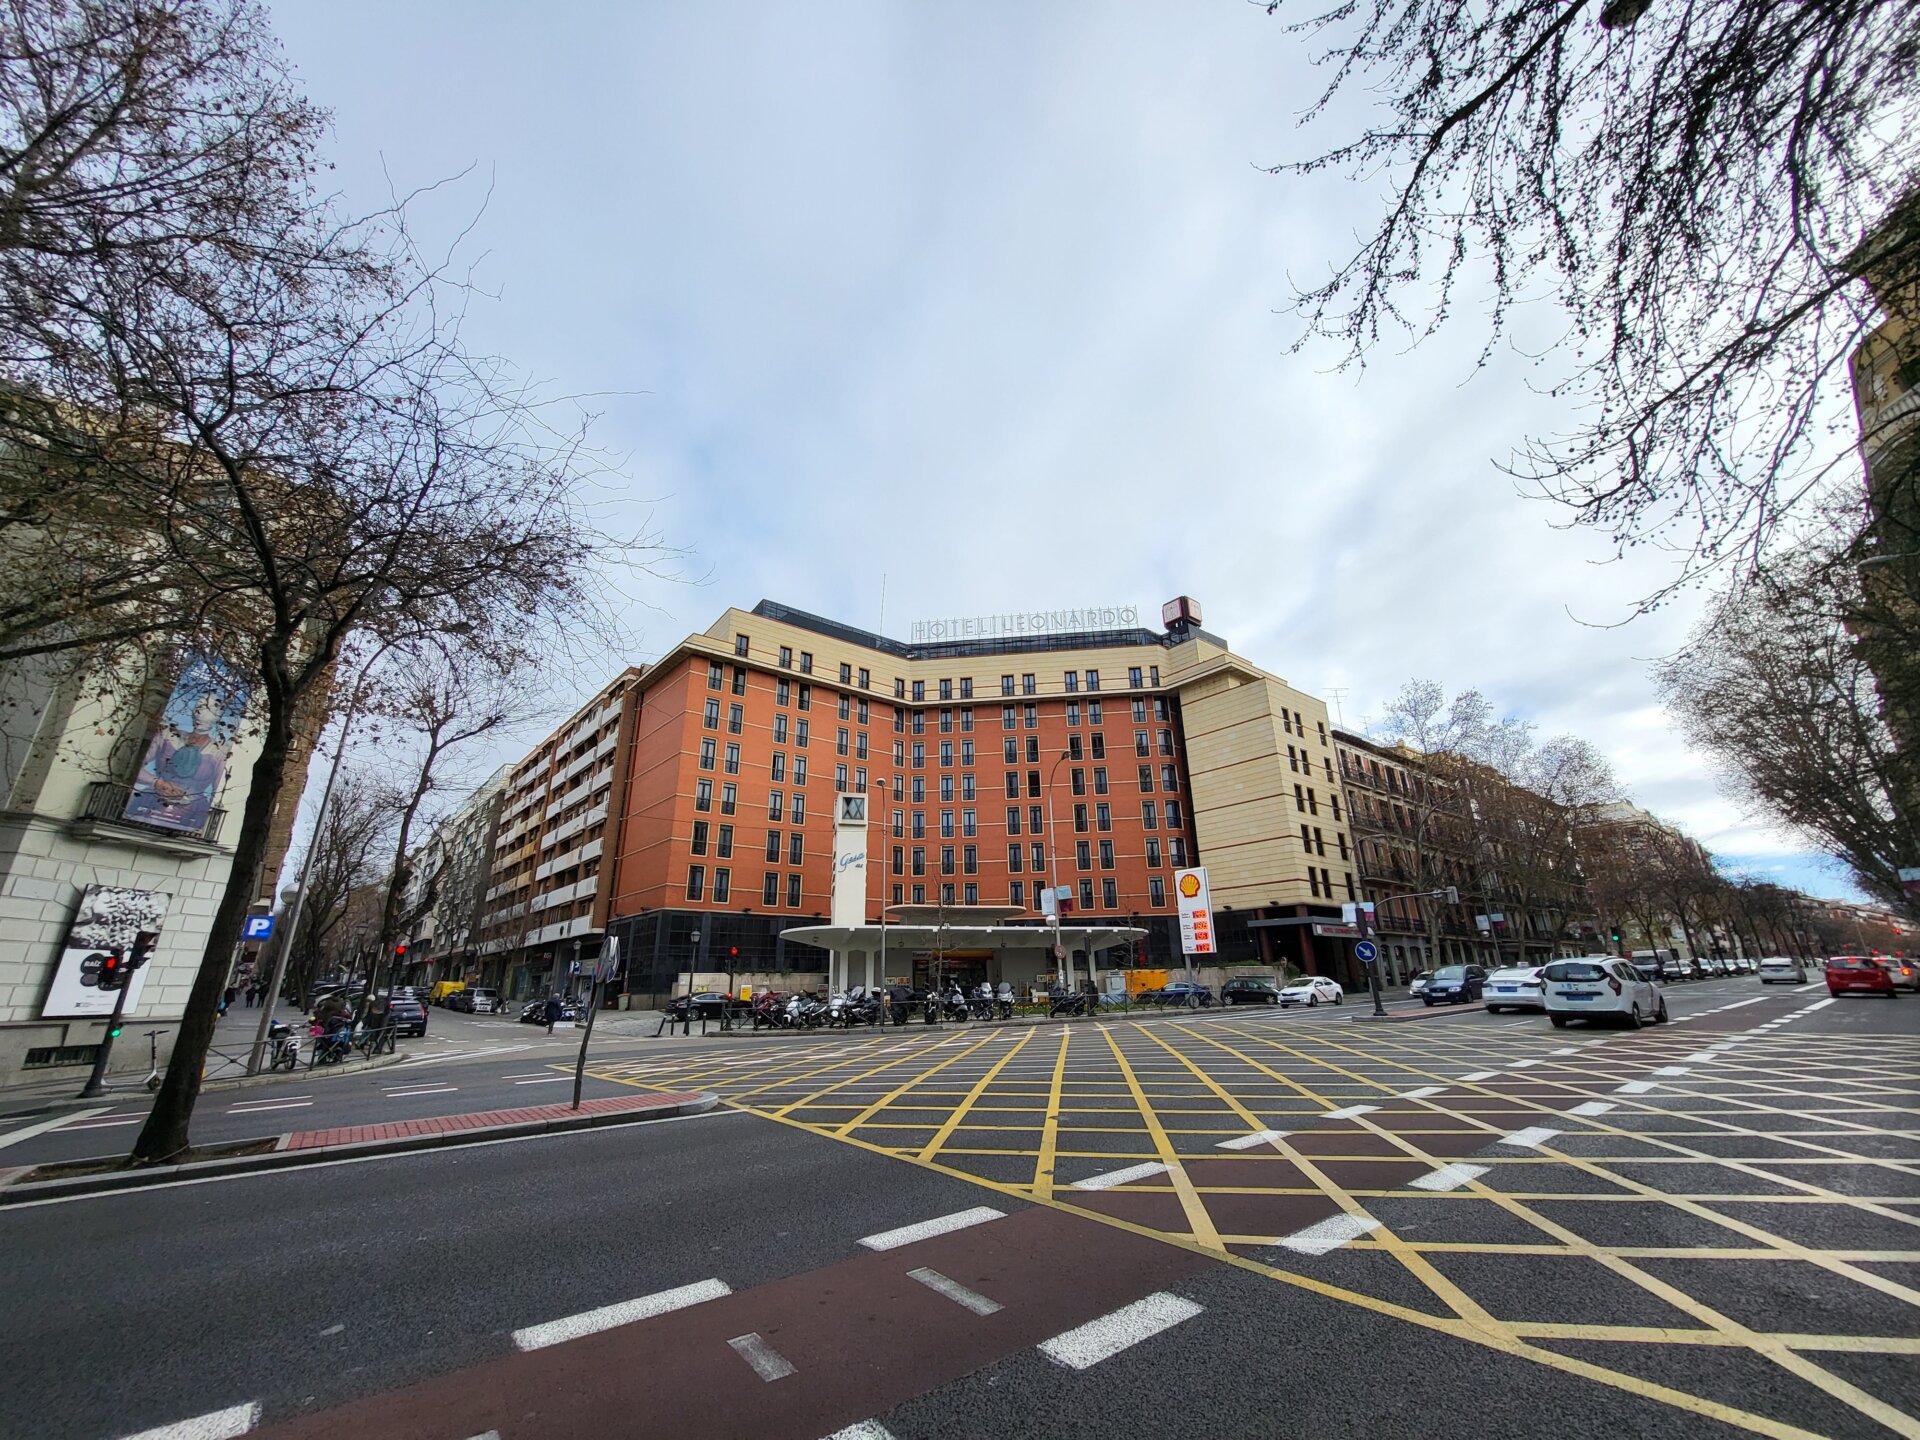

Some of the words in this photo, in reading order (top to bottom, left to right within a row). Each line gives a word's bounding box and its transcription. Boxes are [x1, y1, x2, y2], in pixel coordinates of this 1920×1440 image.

[914, 618, 987, 639] HOTEL
[1003, 609, 1135, 632] LEONARDO
[248, 918, 270, 936] P
